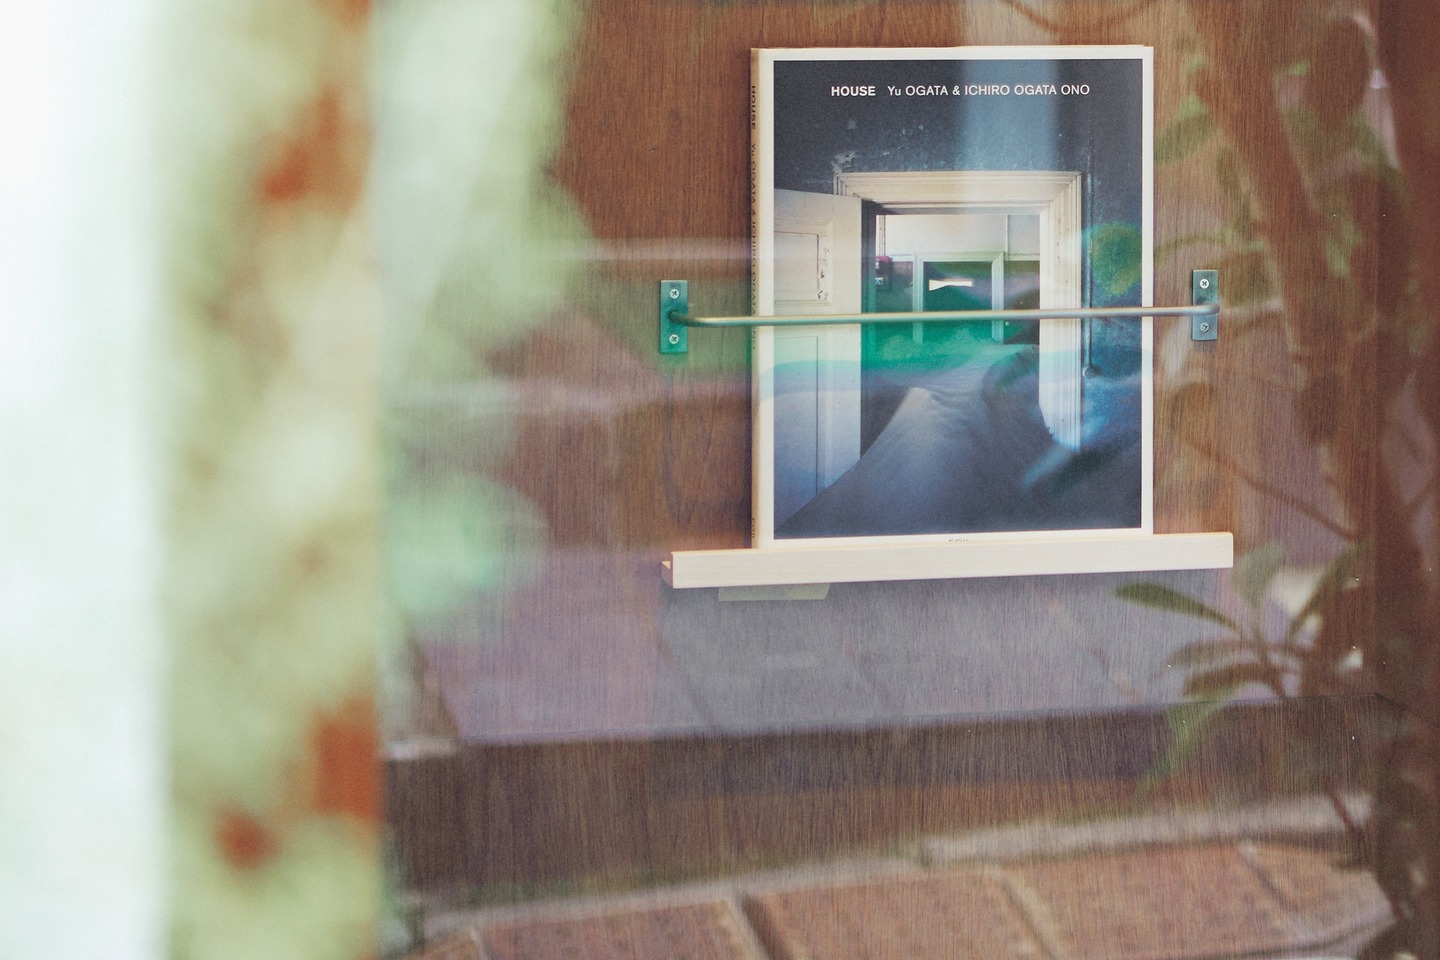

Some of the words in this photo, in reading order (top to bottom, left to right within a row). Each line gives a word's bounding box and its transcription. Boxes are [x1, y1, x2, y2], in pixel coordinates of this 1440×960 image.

[831, 85, 876, 97] HOUSE
[887, 85, 902, 96] Yu
[905, 85, 949, 96] OGATA
[952, 85, 961, 96] &
[964, 84, 1010, 96] ICHIRO
[1014, 84, 1057, 96] OGATA
[1060, 84, 1090, 96] ONO
